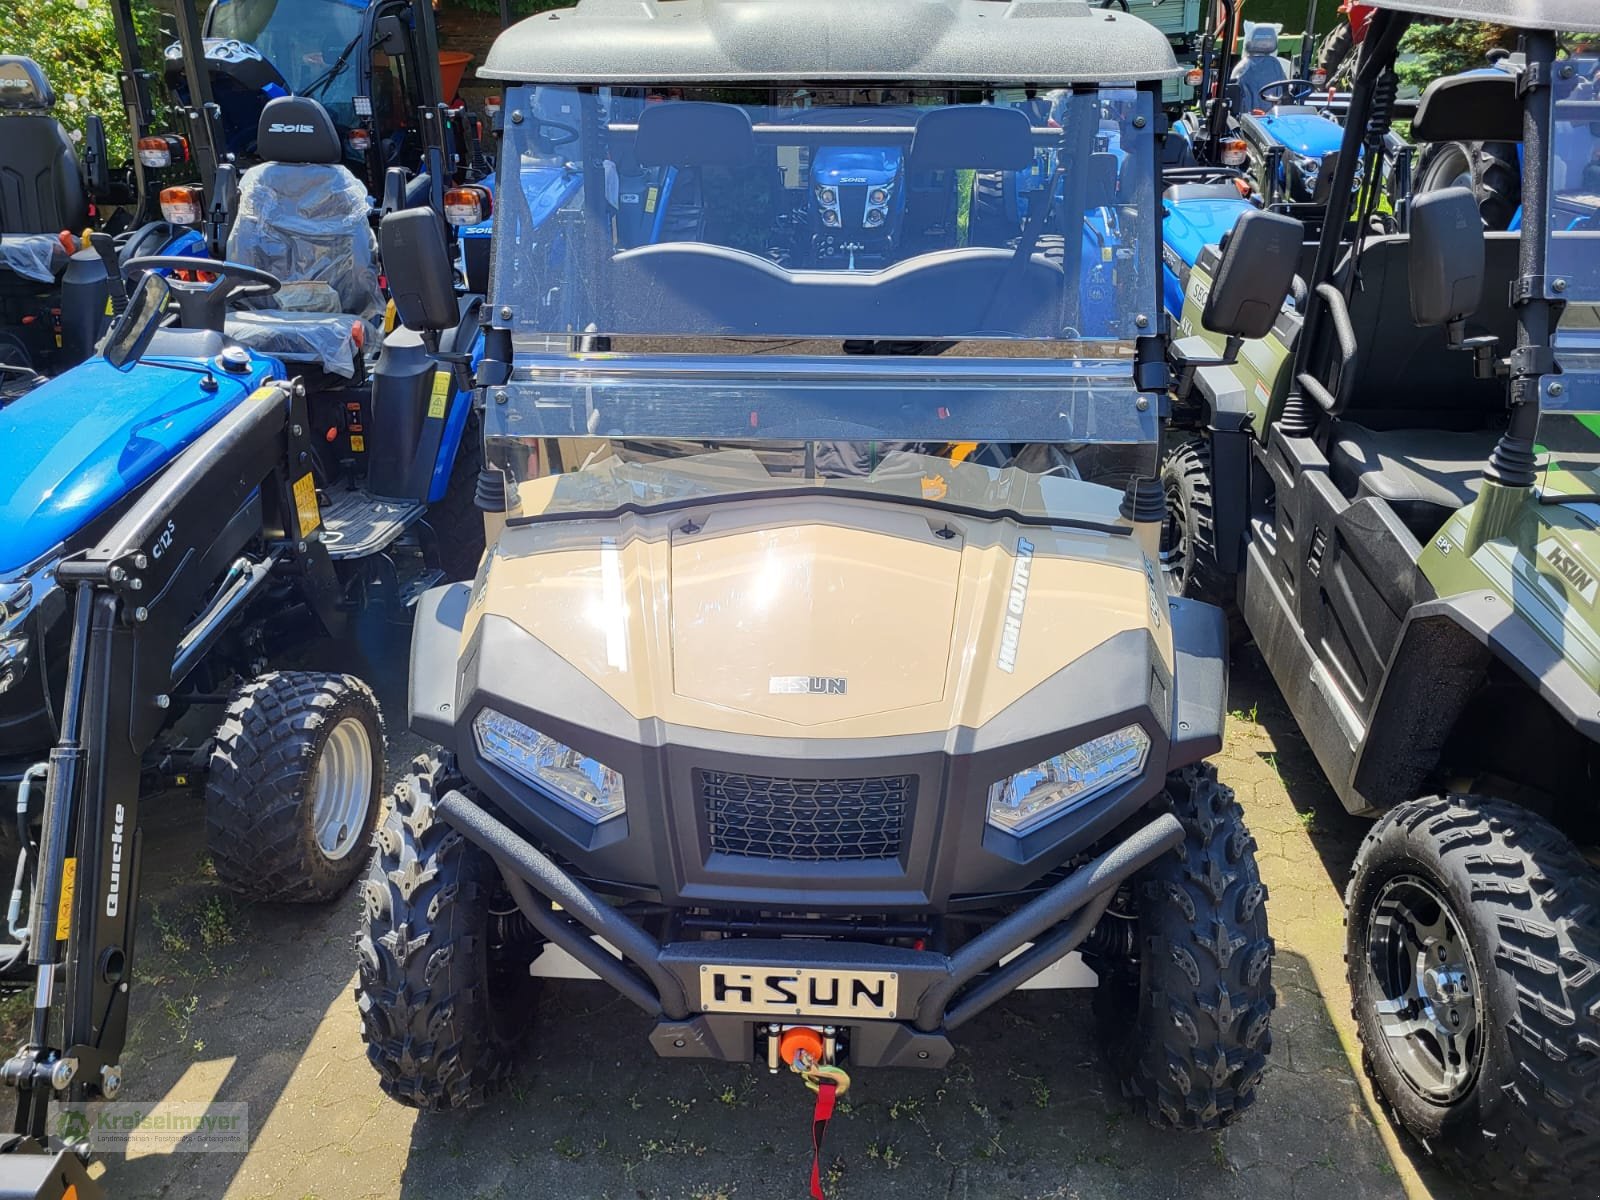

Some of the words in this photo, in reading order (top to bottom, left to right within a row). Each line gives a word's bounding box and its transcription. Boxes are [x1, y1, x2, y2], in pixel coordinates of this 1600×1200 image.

[1008, 536, 1035, 615] OUTPUT
[1435, 535, 1452, 554] EPS
[997, 615, 1021, 674] HIGH
[106, 803, 125, 917] Quicke
